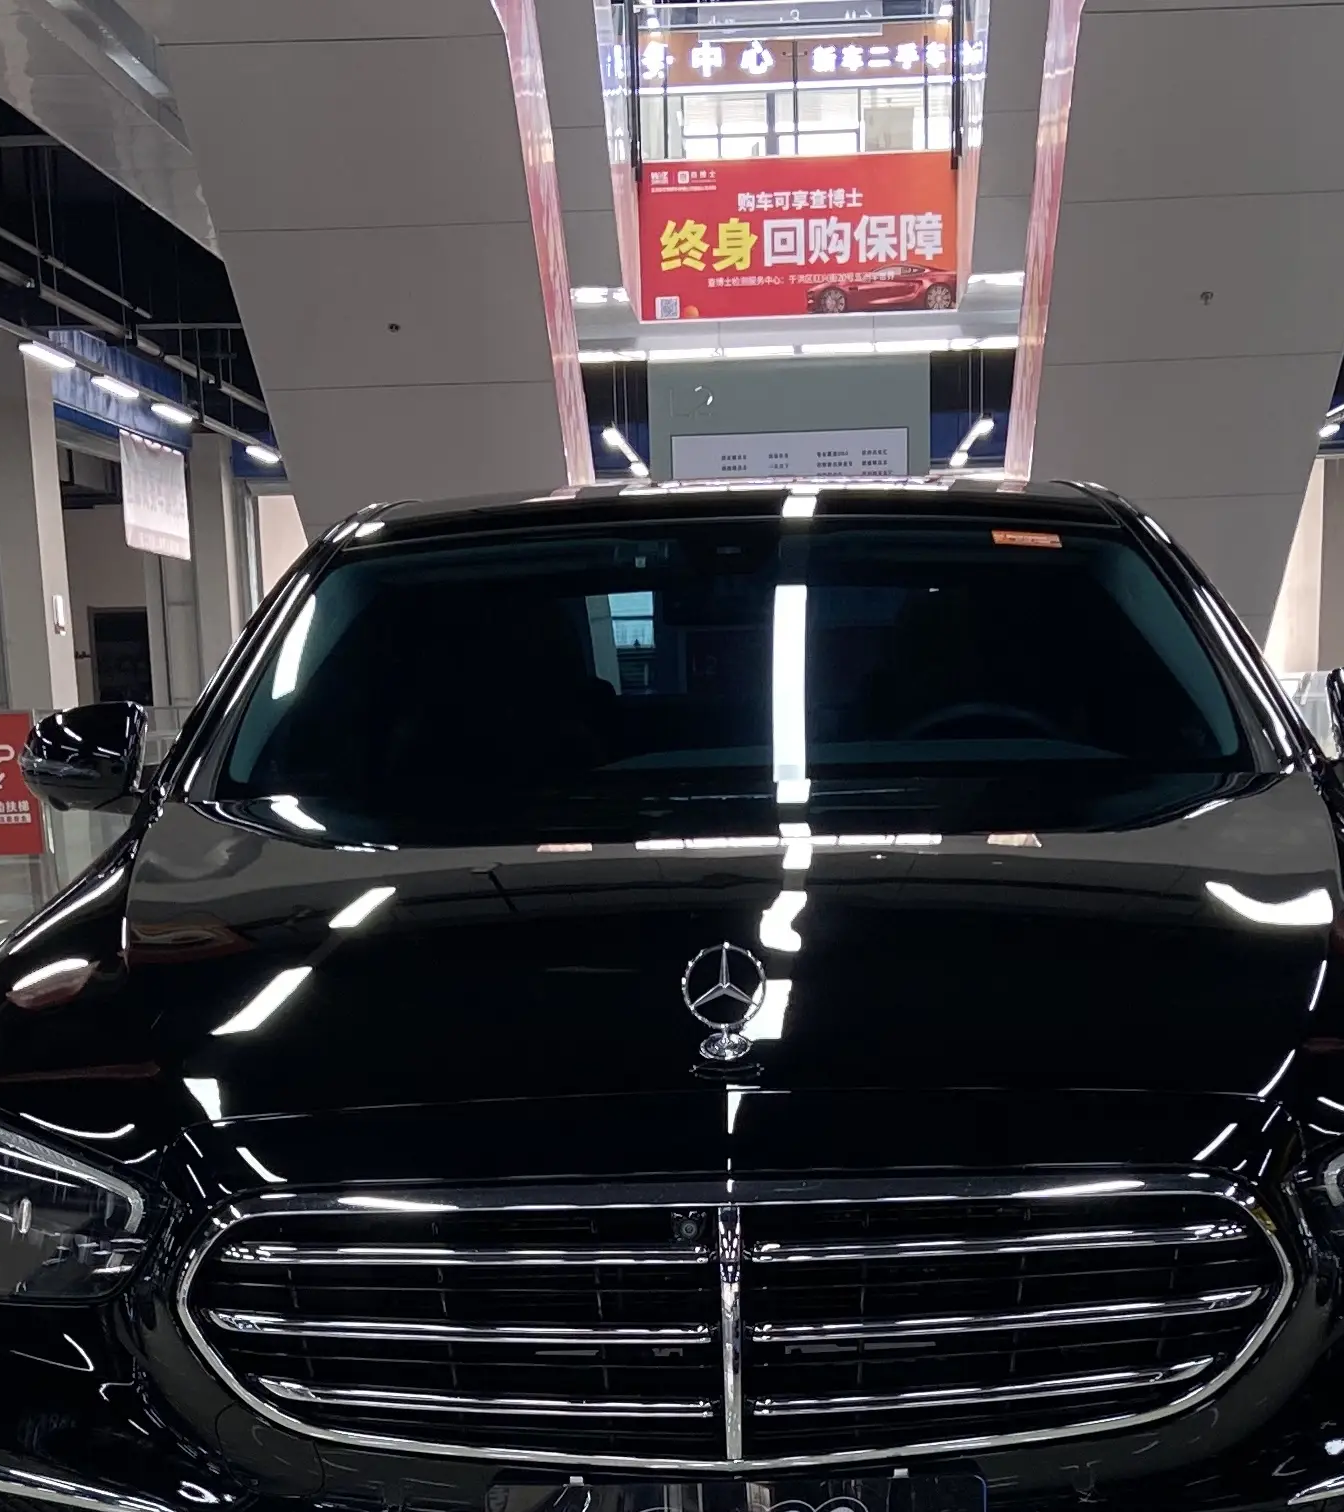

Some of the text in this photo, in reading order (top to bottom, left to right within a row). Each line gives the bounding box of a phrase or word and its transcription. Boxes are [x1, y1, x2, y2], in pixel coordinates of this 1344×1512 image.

[737, 188, 864, 212] 购车可享查博士
[659, 211, 944, 273] 终身回购保障
